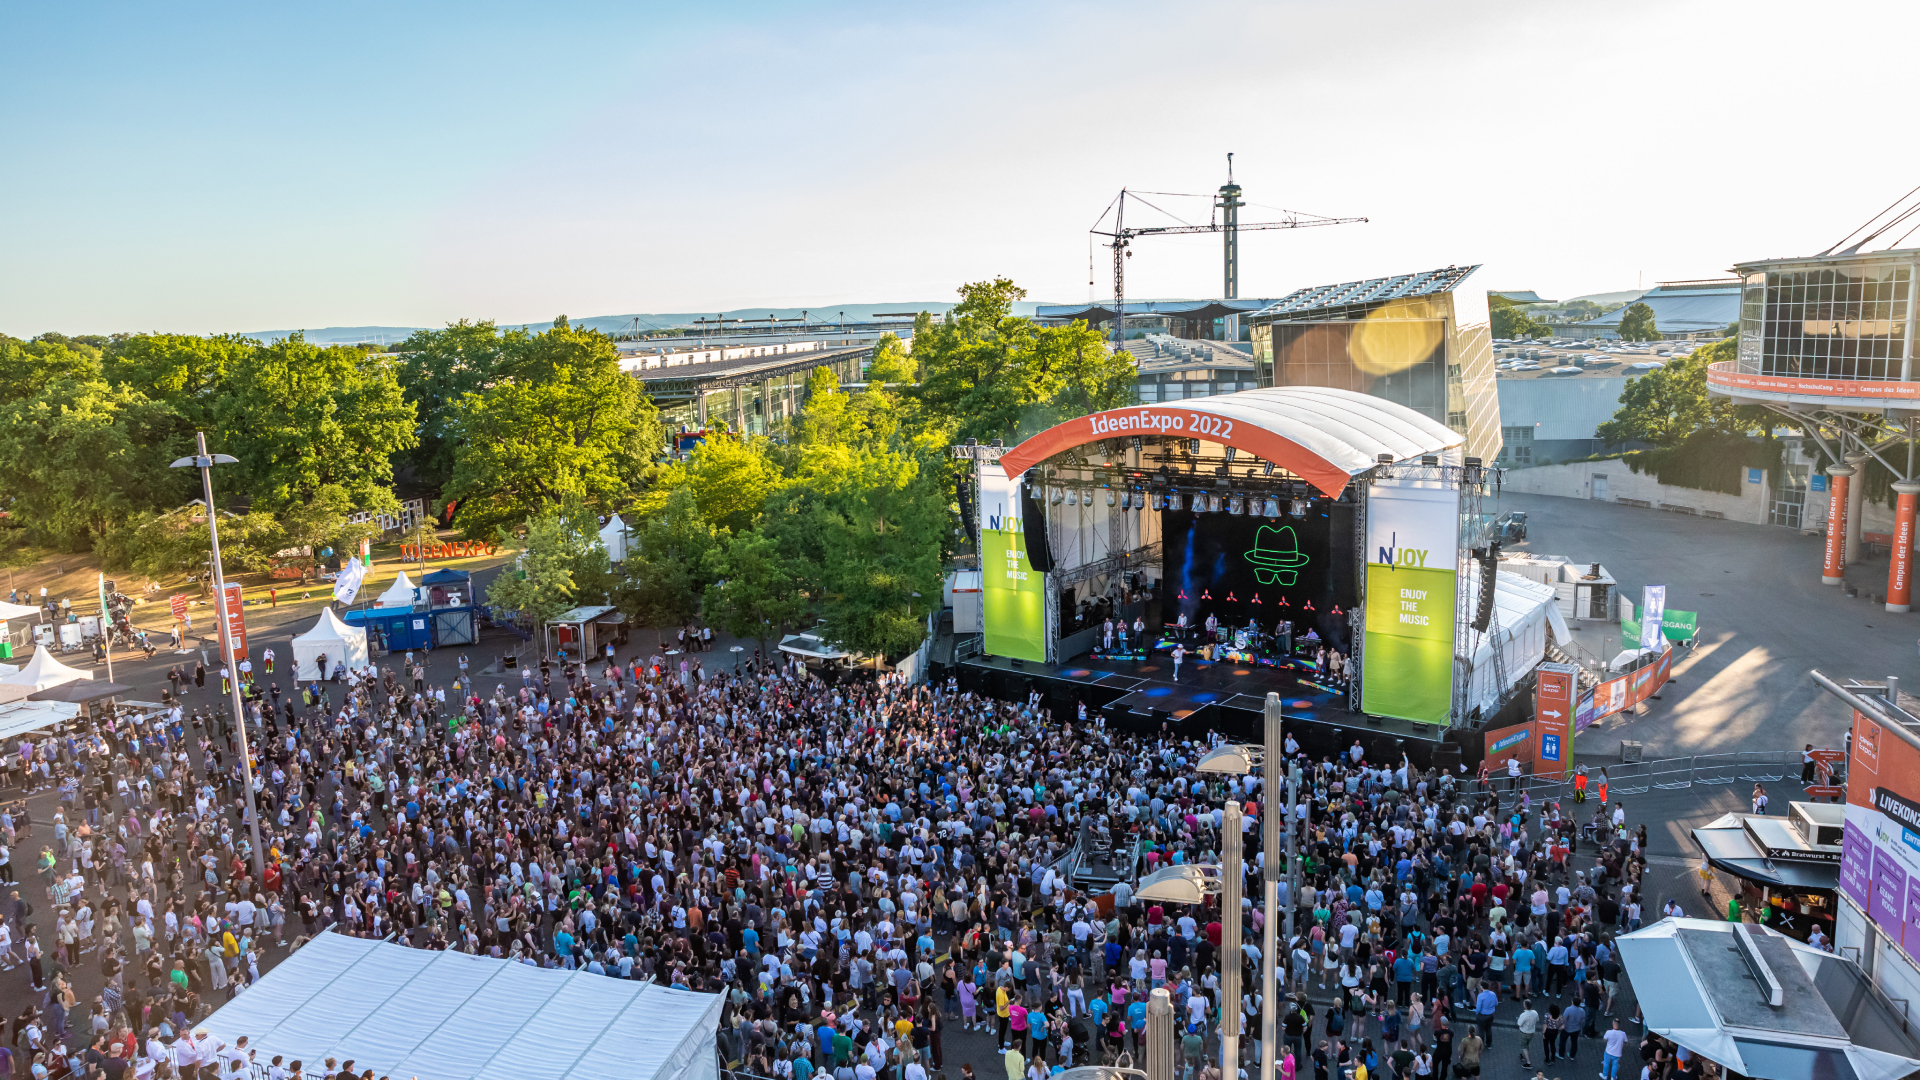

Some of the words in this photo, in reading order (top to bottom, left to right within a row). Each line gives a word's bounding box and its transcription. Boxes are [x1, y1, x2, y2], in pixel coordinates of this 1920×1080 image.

[1089, 410, 1184, 435] IdeenExpo
[1189, 414, 1233, 439] 2022
[1899, 522, 1909, 545] Ideen
[1006, 550, 1025, 559] ENJOY
[1824, 538, 1833, 570] Campus
[1897, 544, 1907, 559] der
[1007, 560, 1019, 569] THE
[1006, 570, 1027, 580] MUSIC
[1894, 560, 1906, 590] Campus
[1400, 588, 1427, 600] ENJOY
[1400, 601, 1417, 612] THE
[1399, 613, 1429, 626] MUSIC
[1791, 851, 1825, 859] Bratwurst
[1879, 886, 1894, 905] GIANT
[1881, 898, 1897, 917] ROOKS
